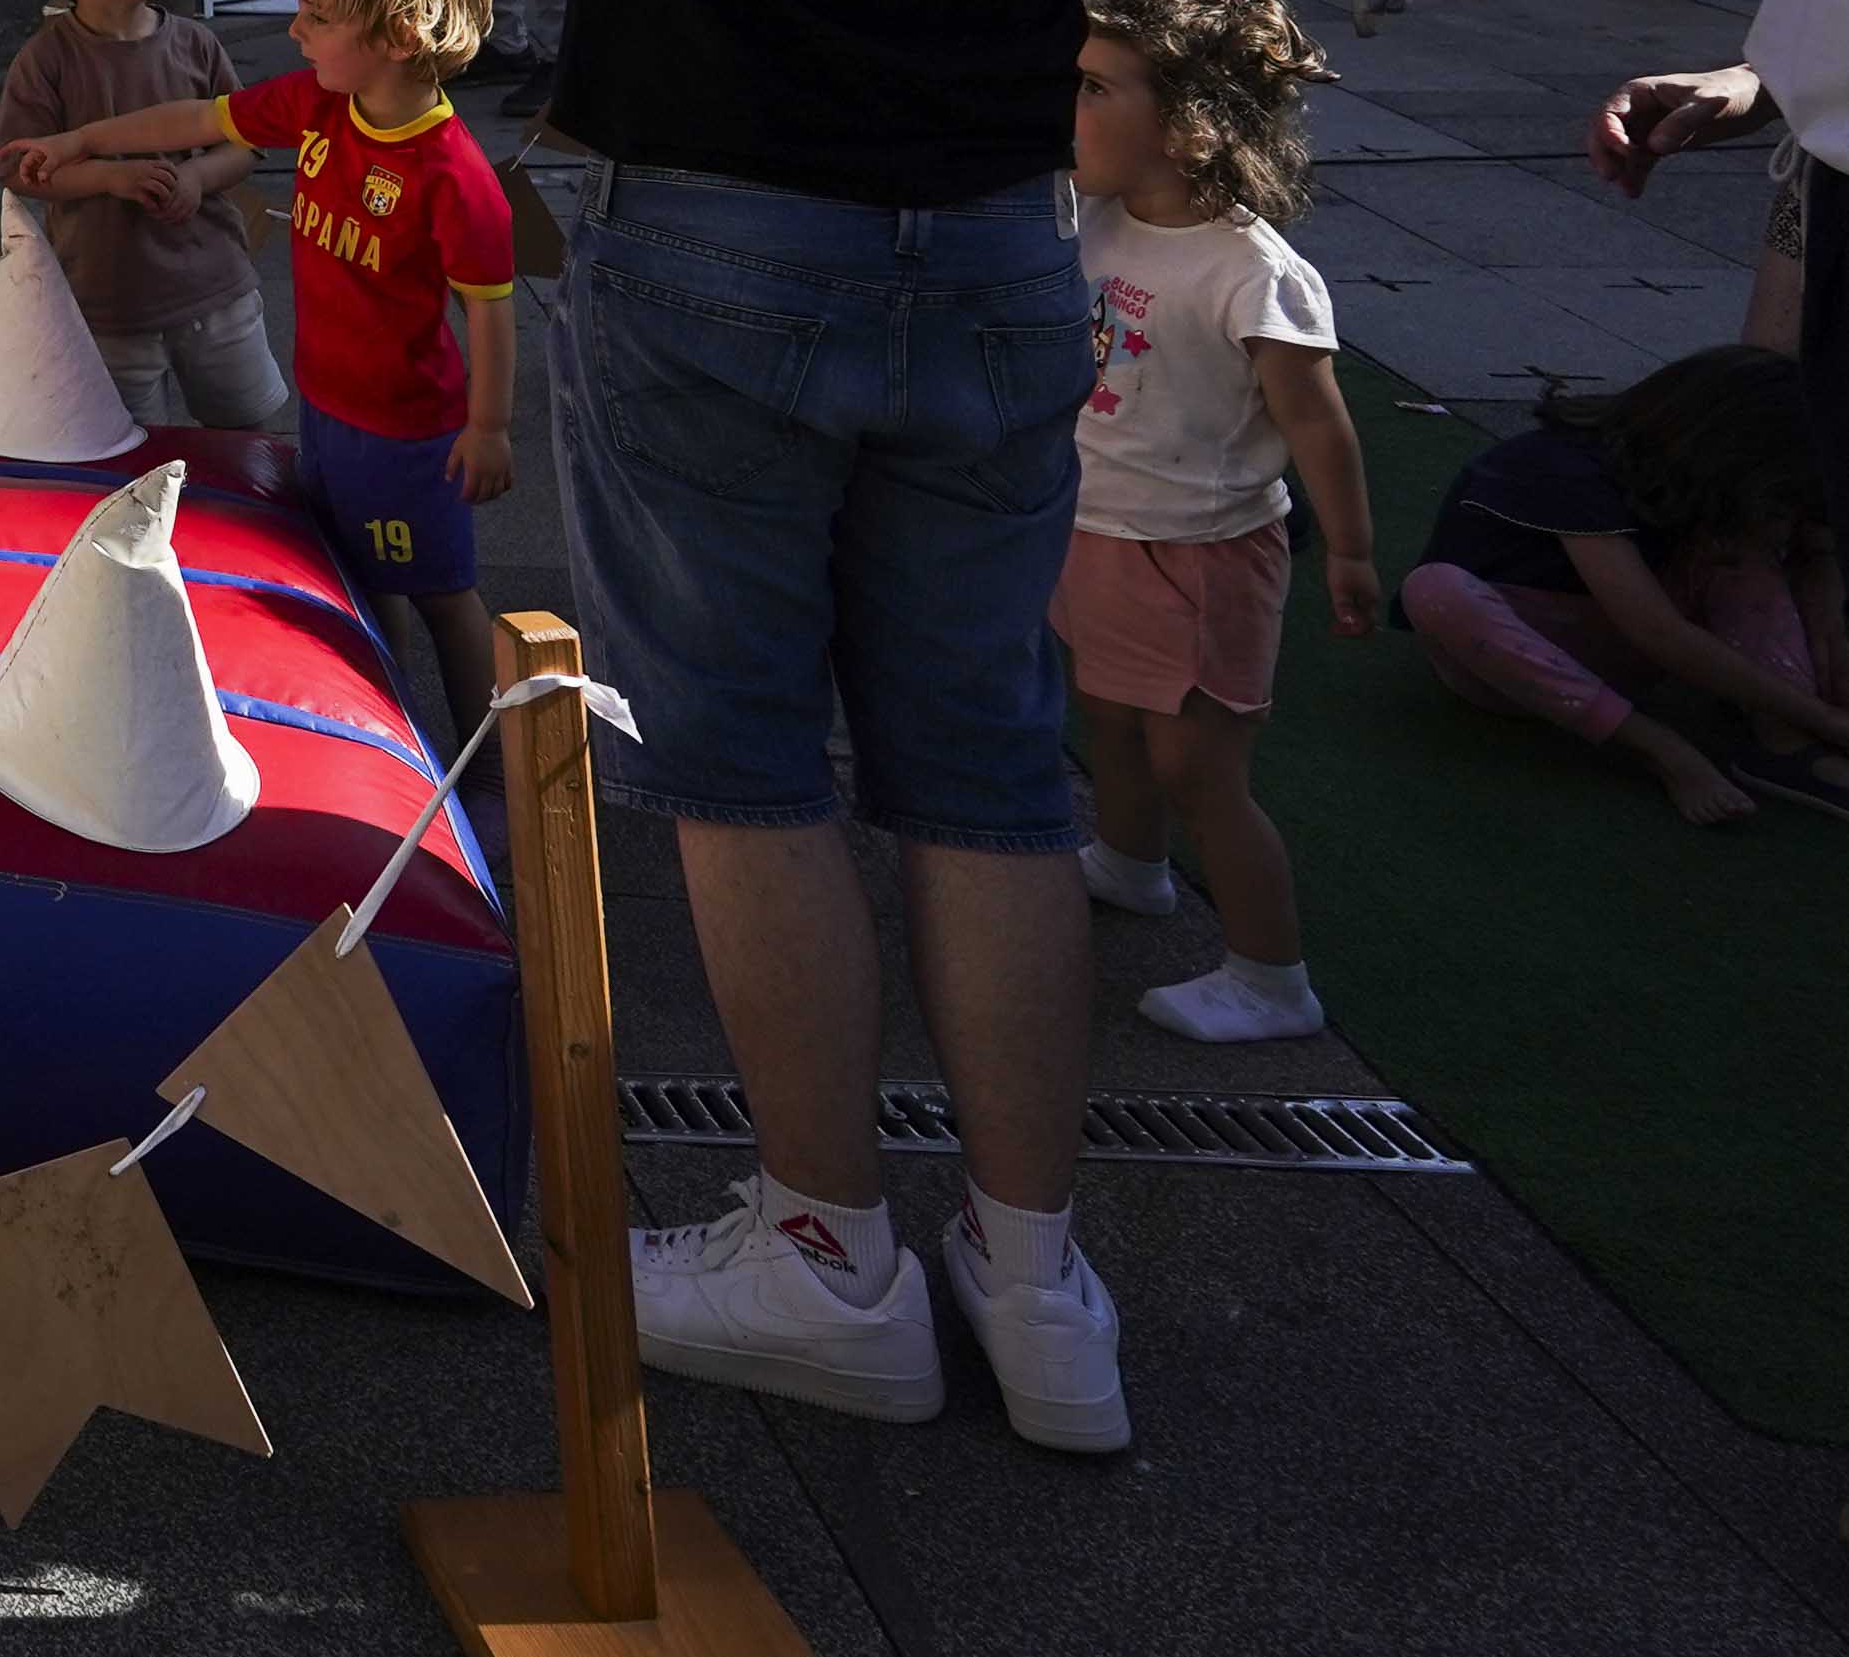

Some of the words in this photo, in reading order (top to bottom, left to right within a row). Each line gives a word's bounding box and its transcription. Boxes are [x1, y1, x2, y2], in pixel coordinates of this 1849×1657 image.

[297, 129, 330, 179] 19
[291, 191, 381, 273] SPAÑA
[364, 518, 414, 563] 19
